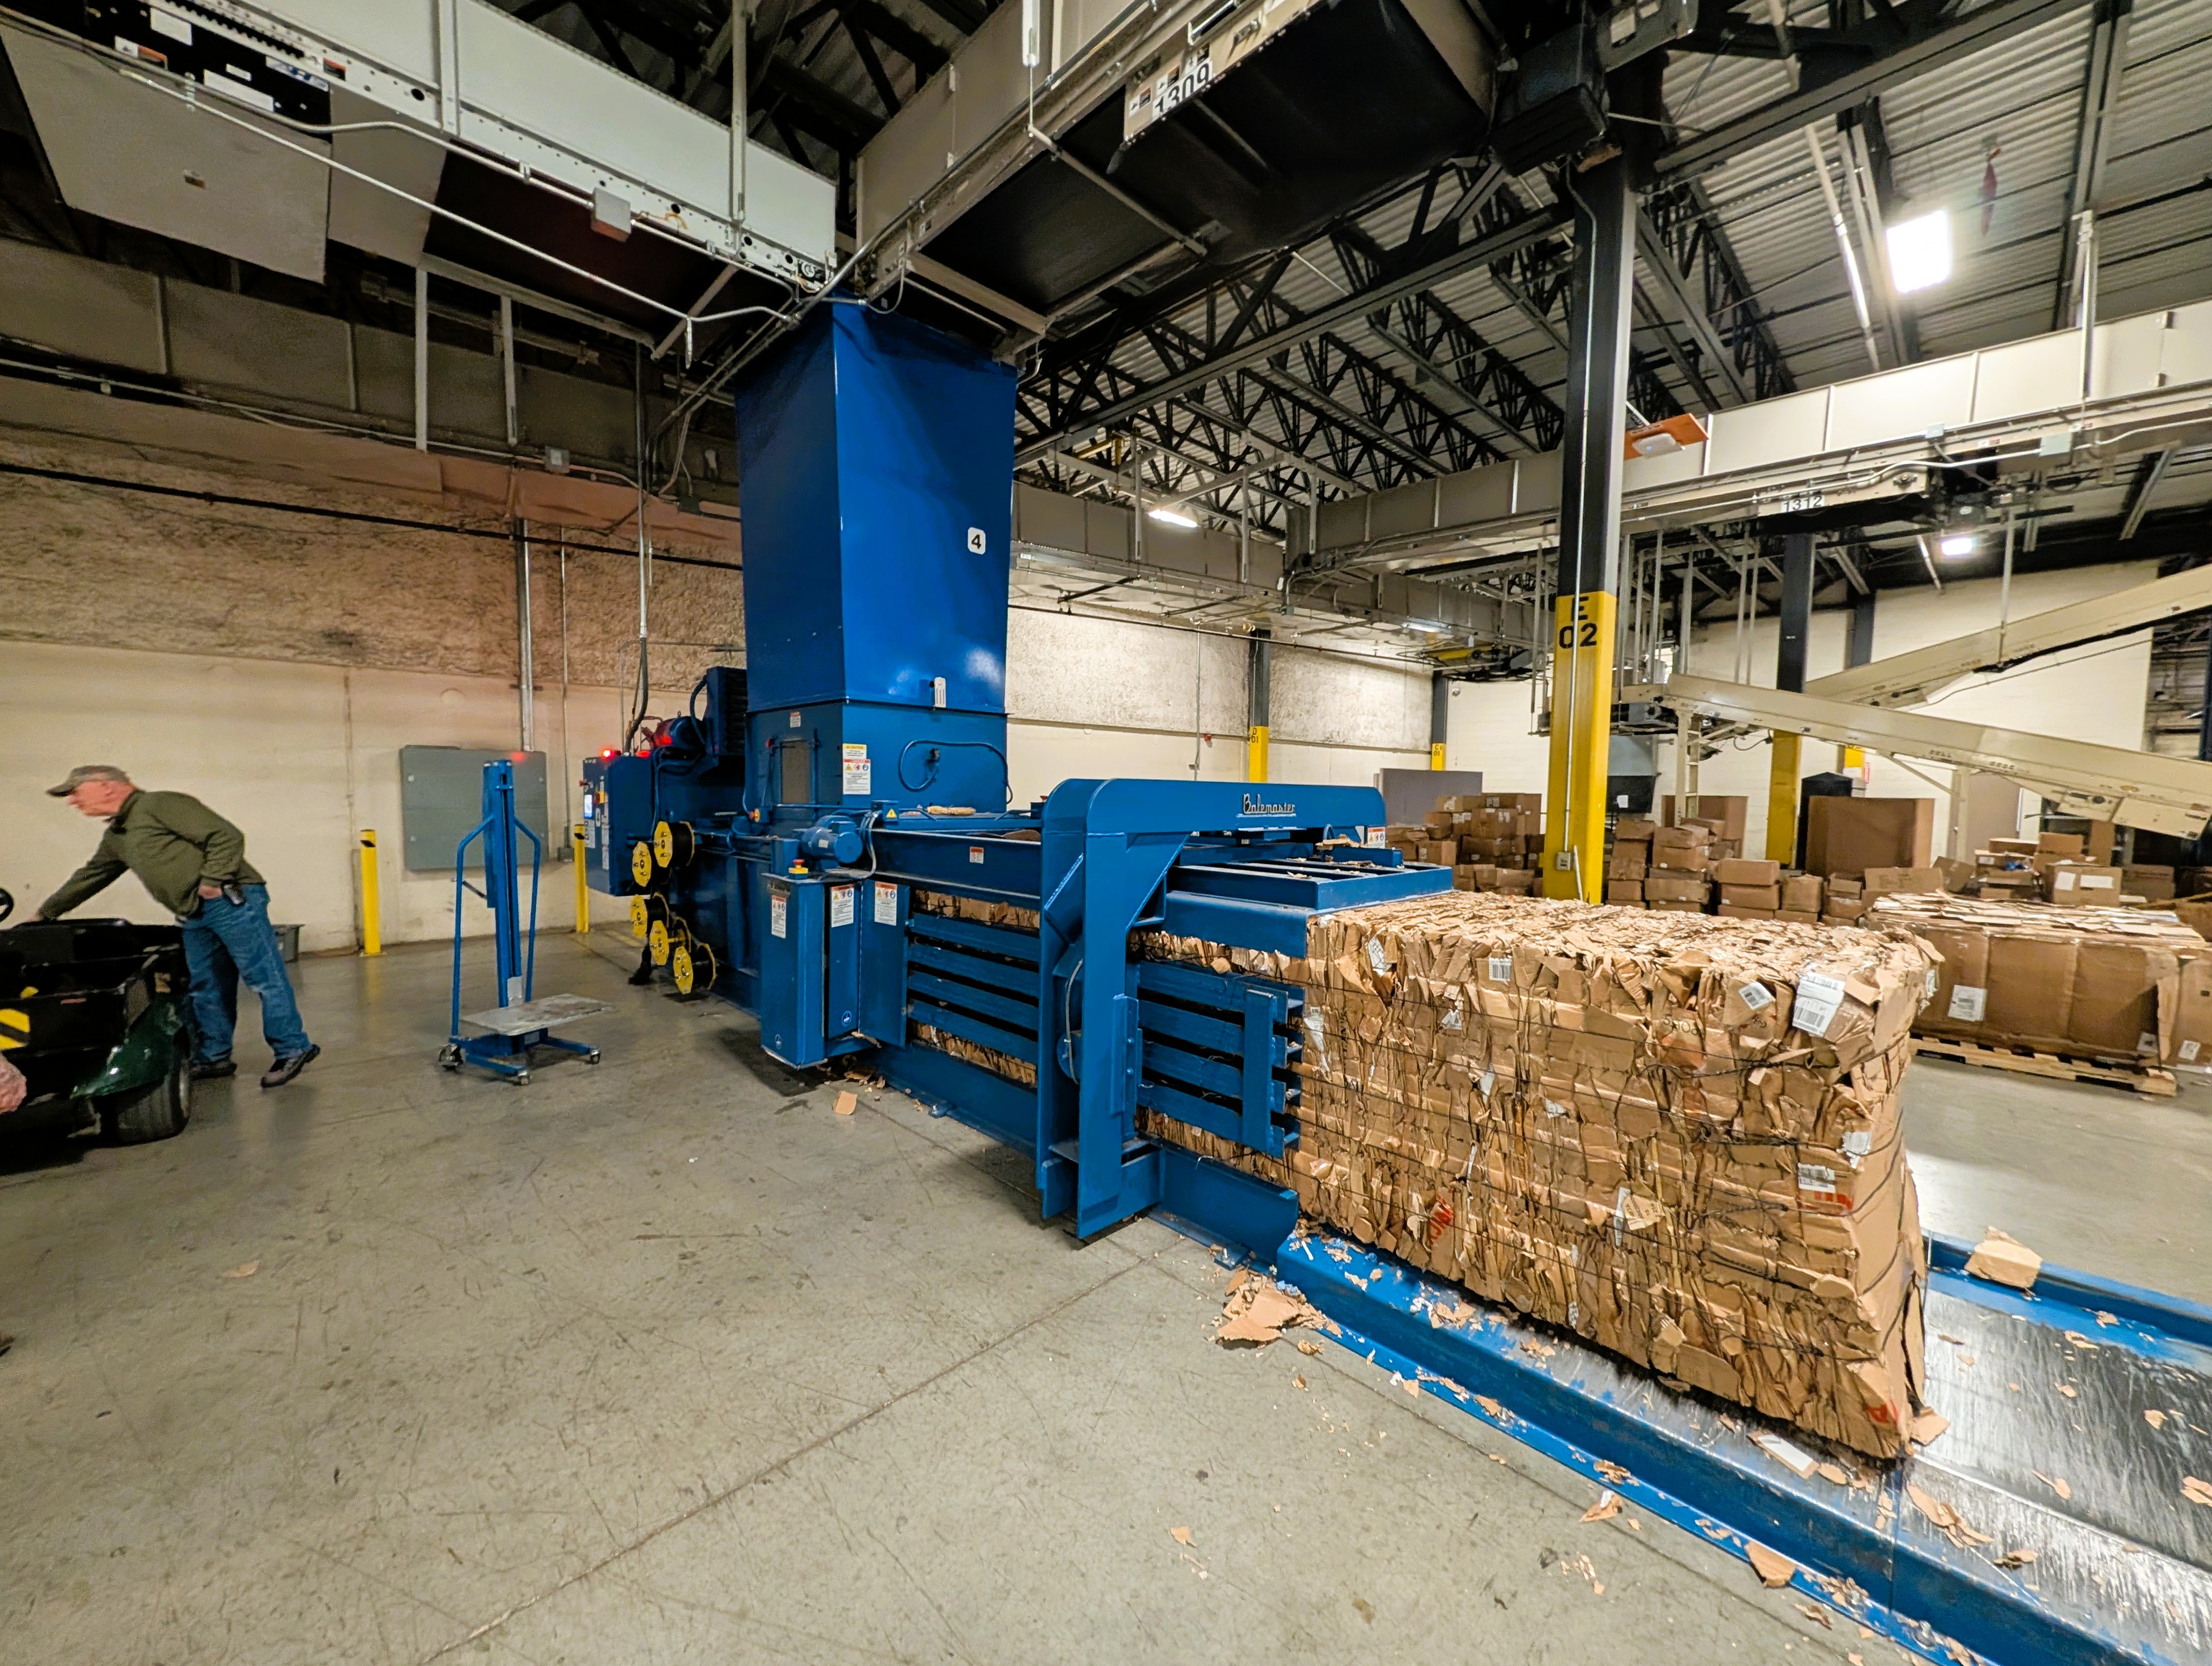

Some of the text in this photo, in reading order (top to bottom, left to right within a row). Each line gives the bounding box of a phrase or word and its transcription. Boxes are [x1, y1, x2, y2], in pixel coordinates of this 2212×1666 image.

[1155, 63, 1210, 112] 1309
[1784, 495, 1823, 511] 1312
[971, 534, 981, 549] 4
[1571, 595, 1589, 621] E
[1559, 623, 1598, 649] 02
[1243, 793, 1296, 814] Balemaster
